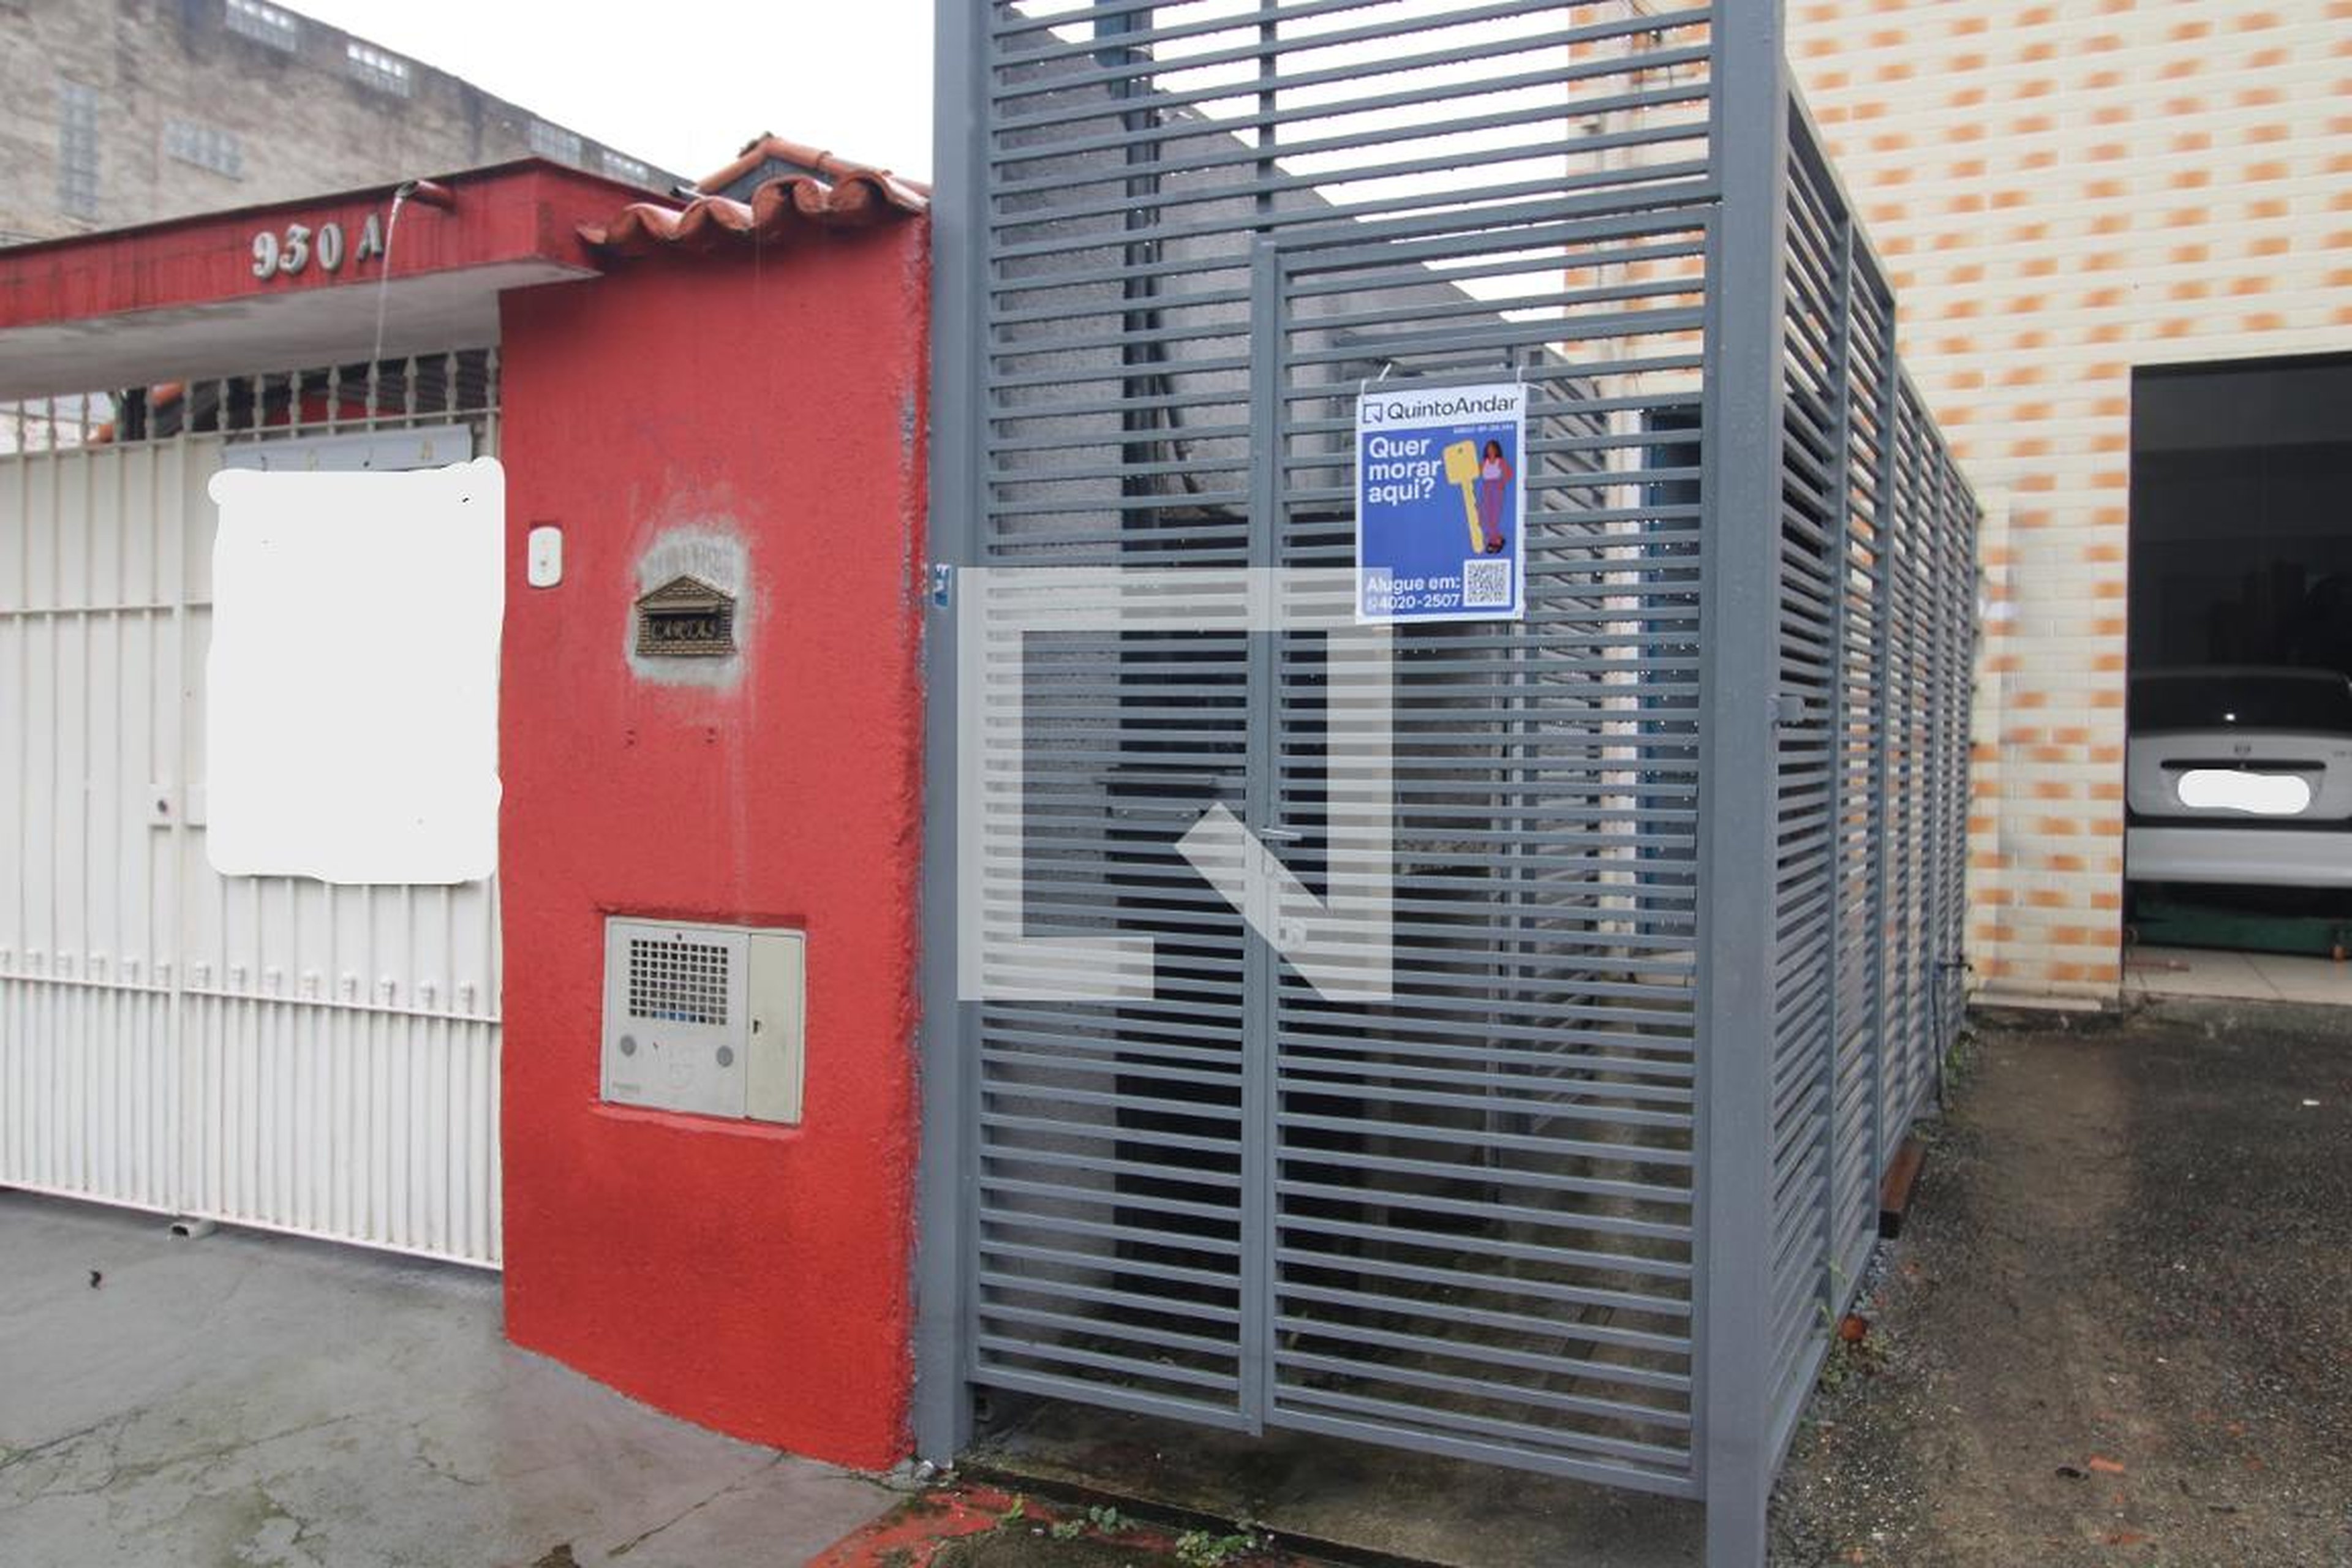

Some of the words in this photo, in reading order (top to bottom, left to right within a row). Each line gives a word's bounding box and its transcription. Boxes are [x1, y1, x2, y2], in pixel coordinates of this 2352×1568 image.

[357, 214, 383, 262] A
[1388, 396, 1518, 420] QuintoAndar
[1369, 437, 1430, 458] Quer
[1369, 459, 1442, 480] morar
[1368, 479, 1434, 505] aqui?
[1366, 578, 1424, 595] Alugue
[1428, 576, 1461, 590] em:
